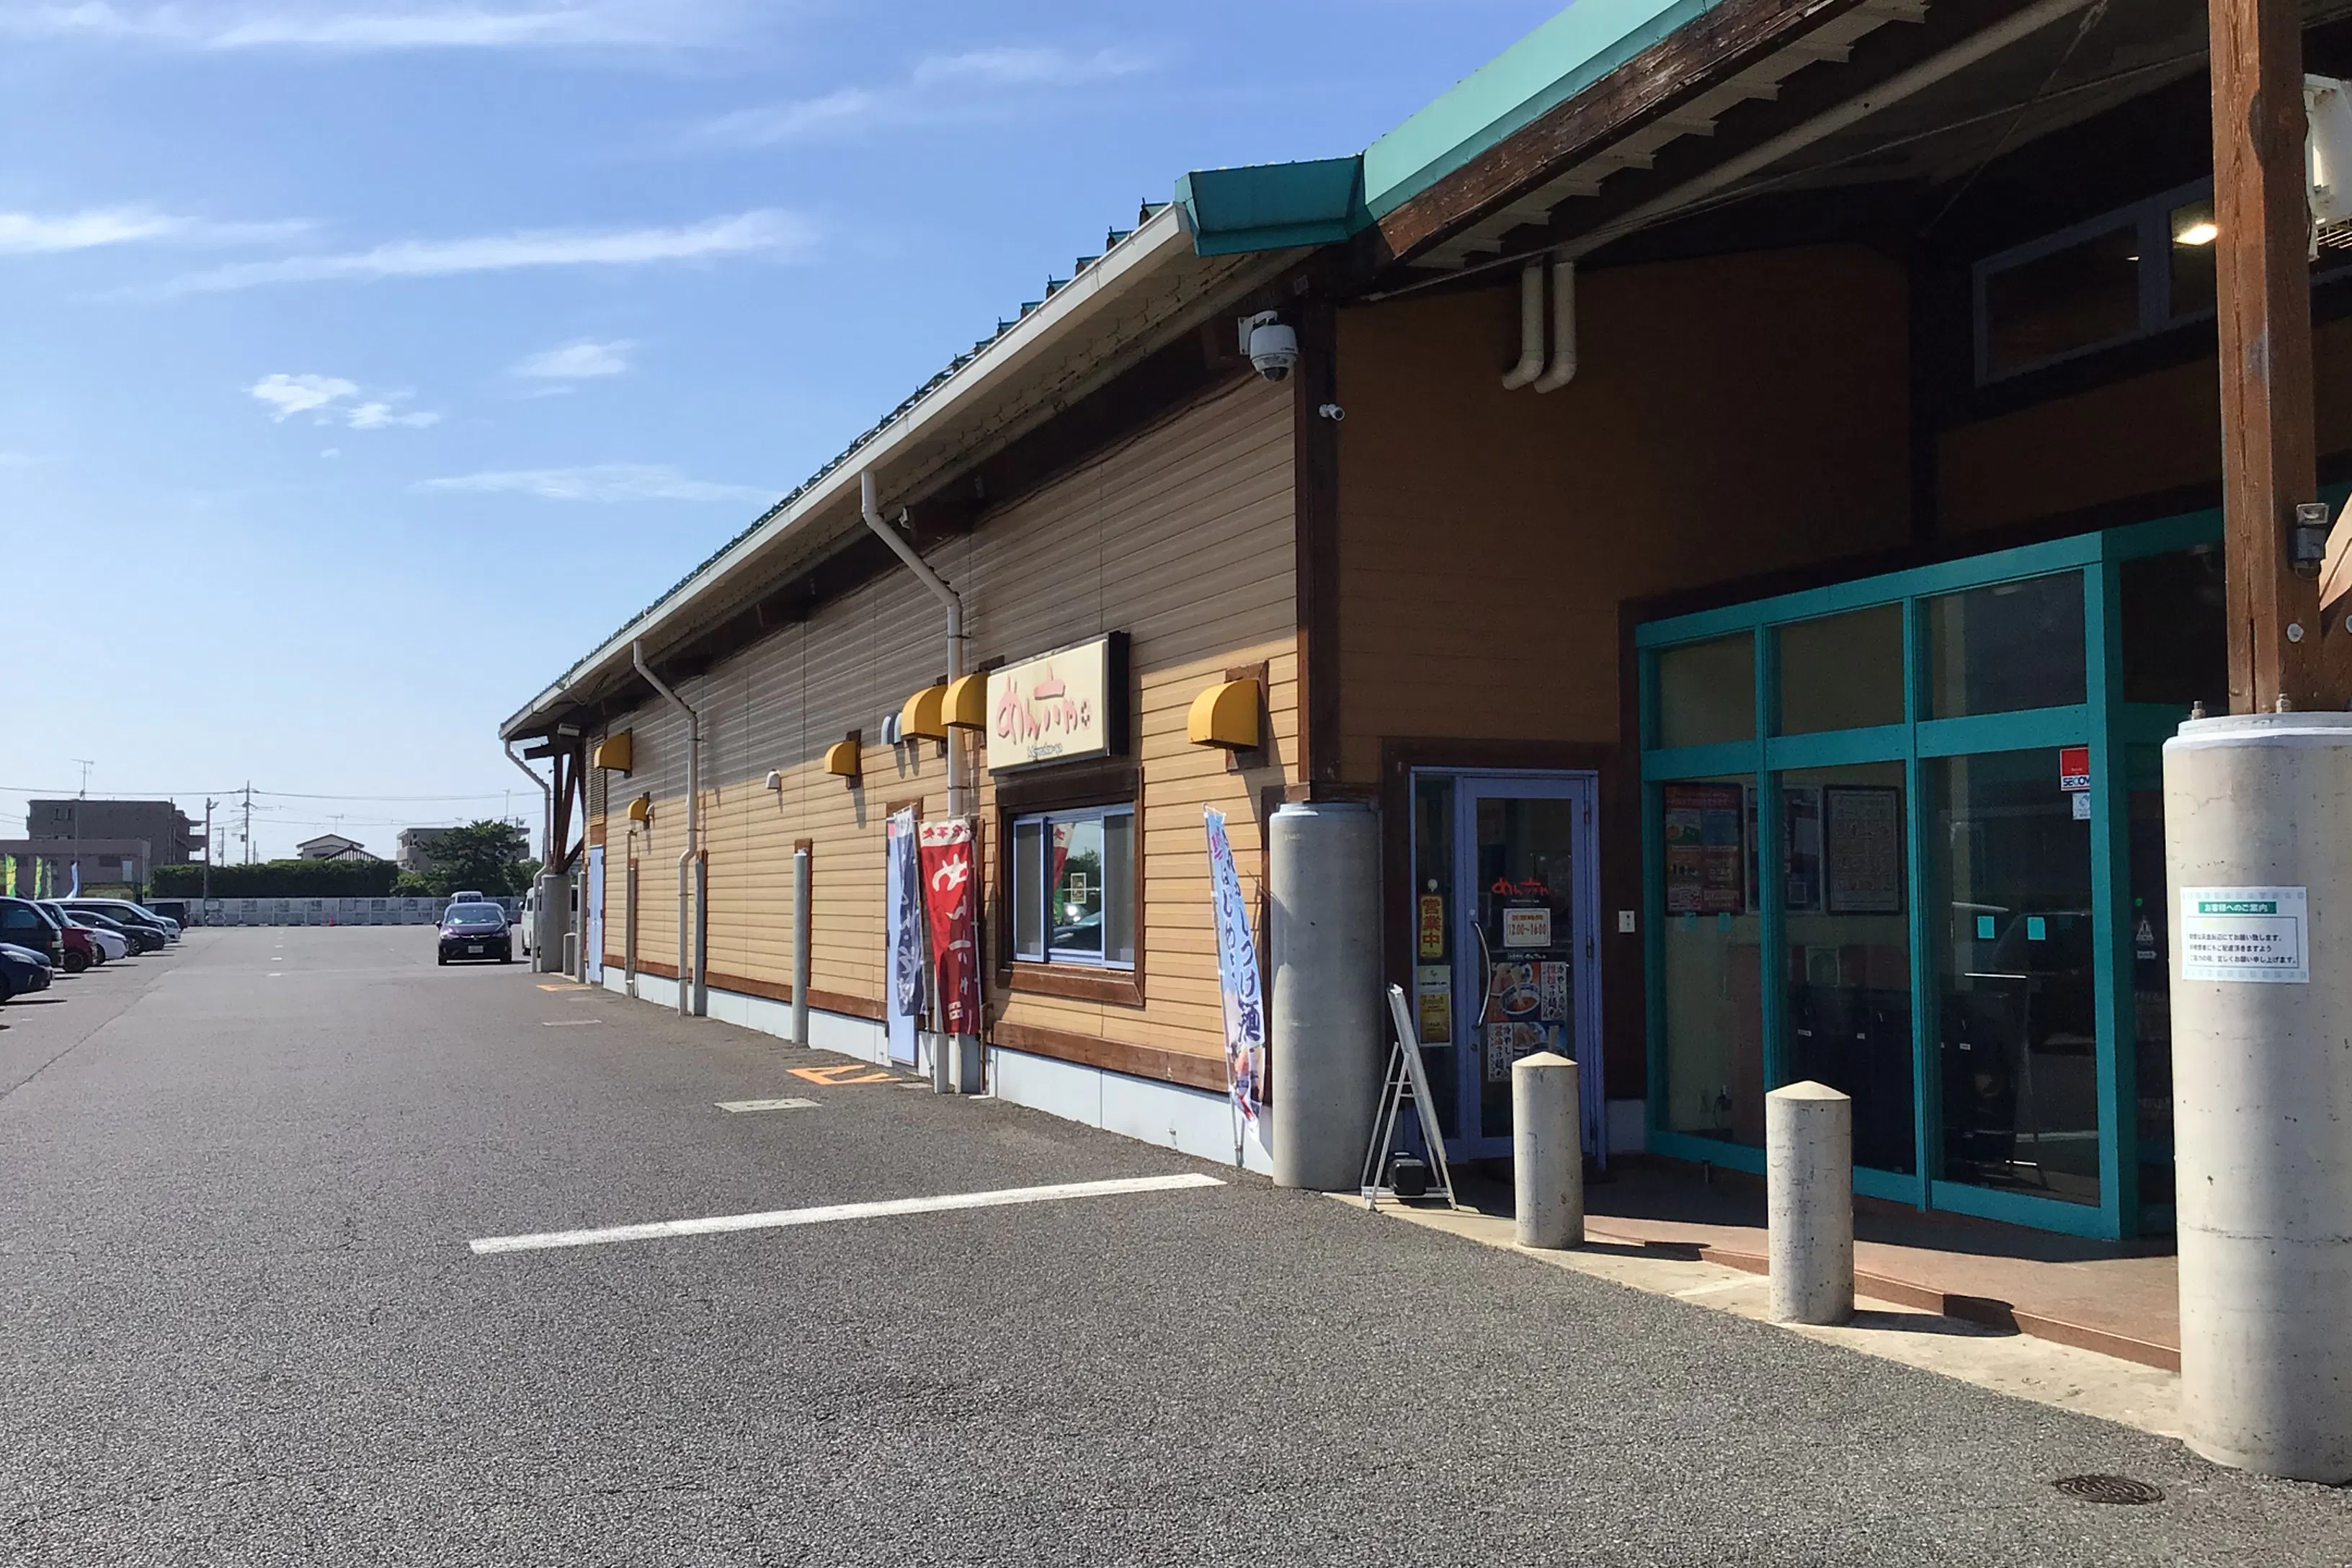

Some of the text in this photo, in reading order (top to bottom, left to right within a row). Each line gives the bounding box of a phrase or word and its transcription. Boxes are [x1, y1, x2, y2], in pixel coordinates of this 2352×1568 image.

[2204, 903, 2269, 912] お客様へのご案内
[1422, 898, 1441, 948] 営業中
